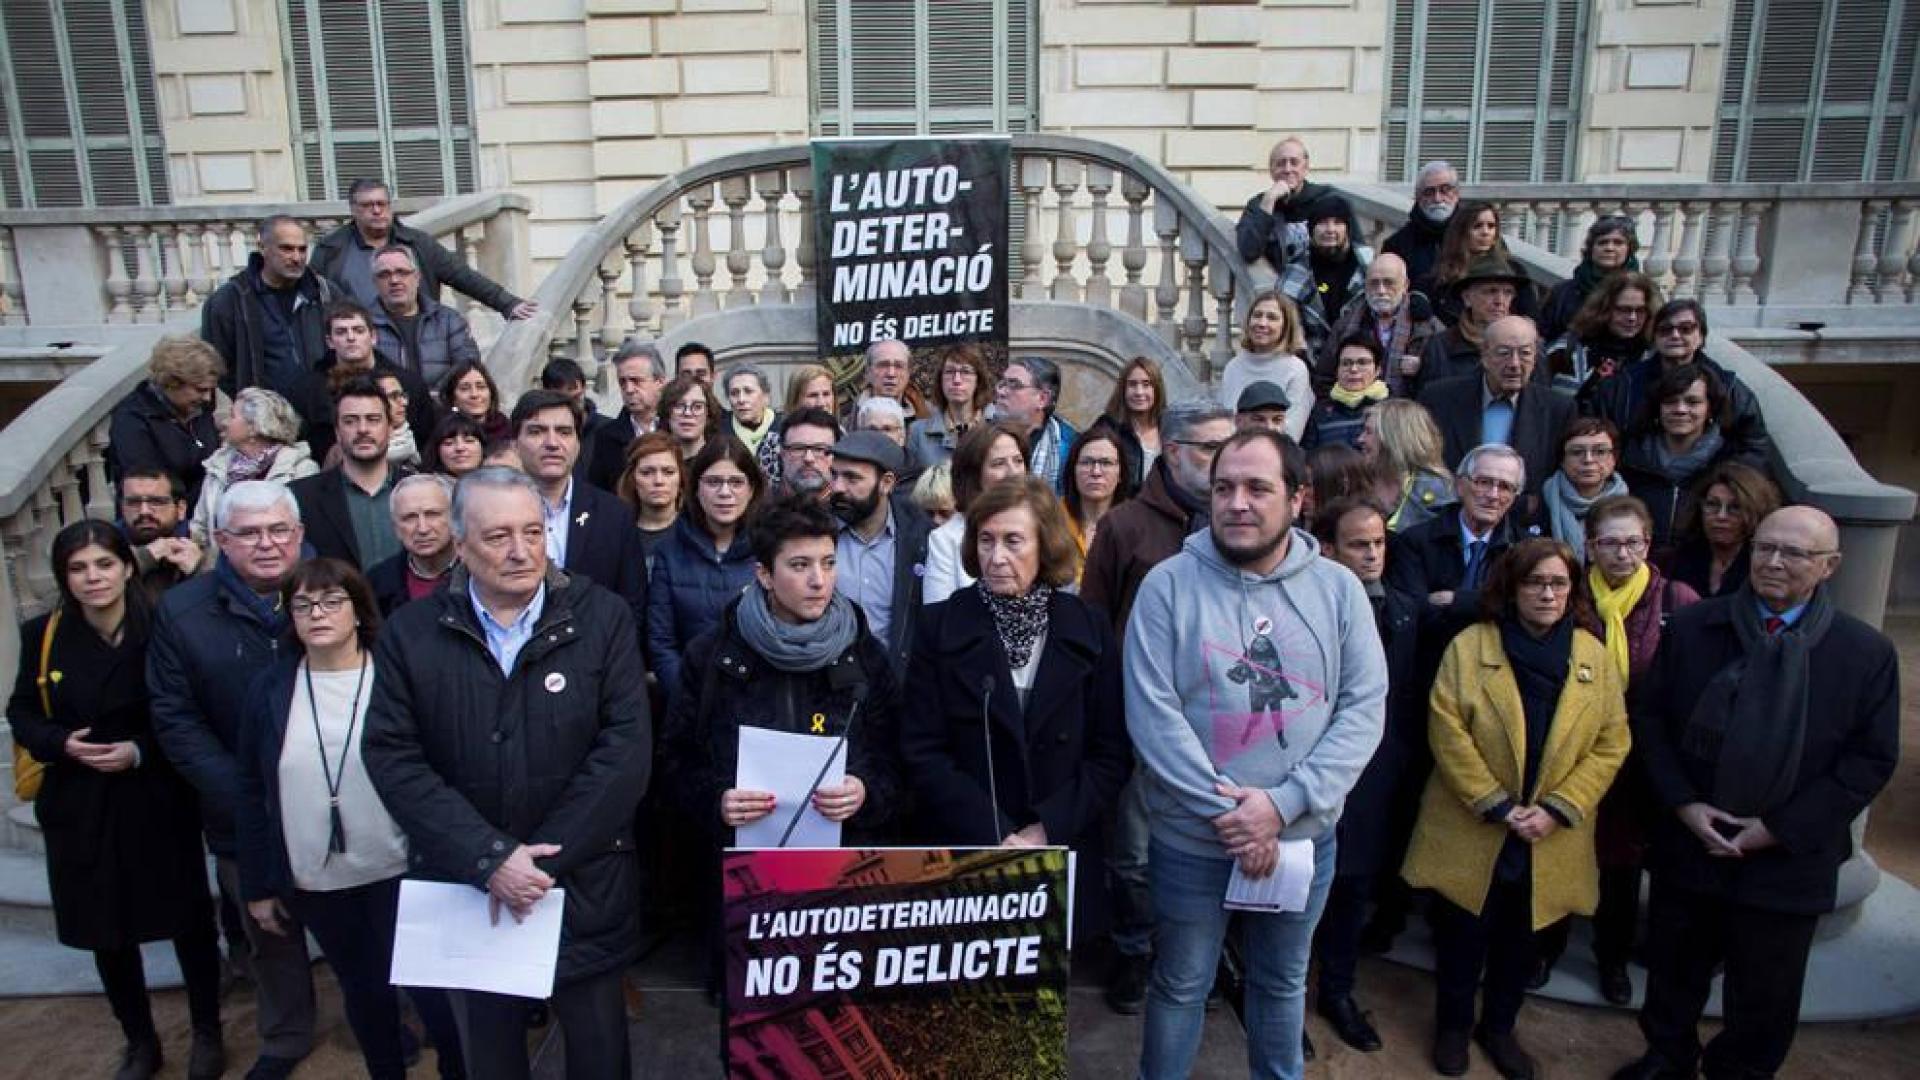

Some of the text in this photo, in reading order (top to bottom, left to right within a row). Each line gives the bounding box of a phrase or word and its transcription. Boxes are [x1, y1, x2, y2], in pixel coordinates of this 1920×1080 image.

[830, 164, 973, 212] L'AUTO-
[831, 212, 964, 259] DETER-
[832, 243, 994, 304] MINACIÓ
[833, 308, 994, 347] NO ÉS DELICTE
[748, 884, 1048, 940] L'AUTODETERMINACIÓ
[744, 935, 1041, 998] NO ÉS DELICTE
